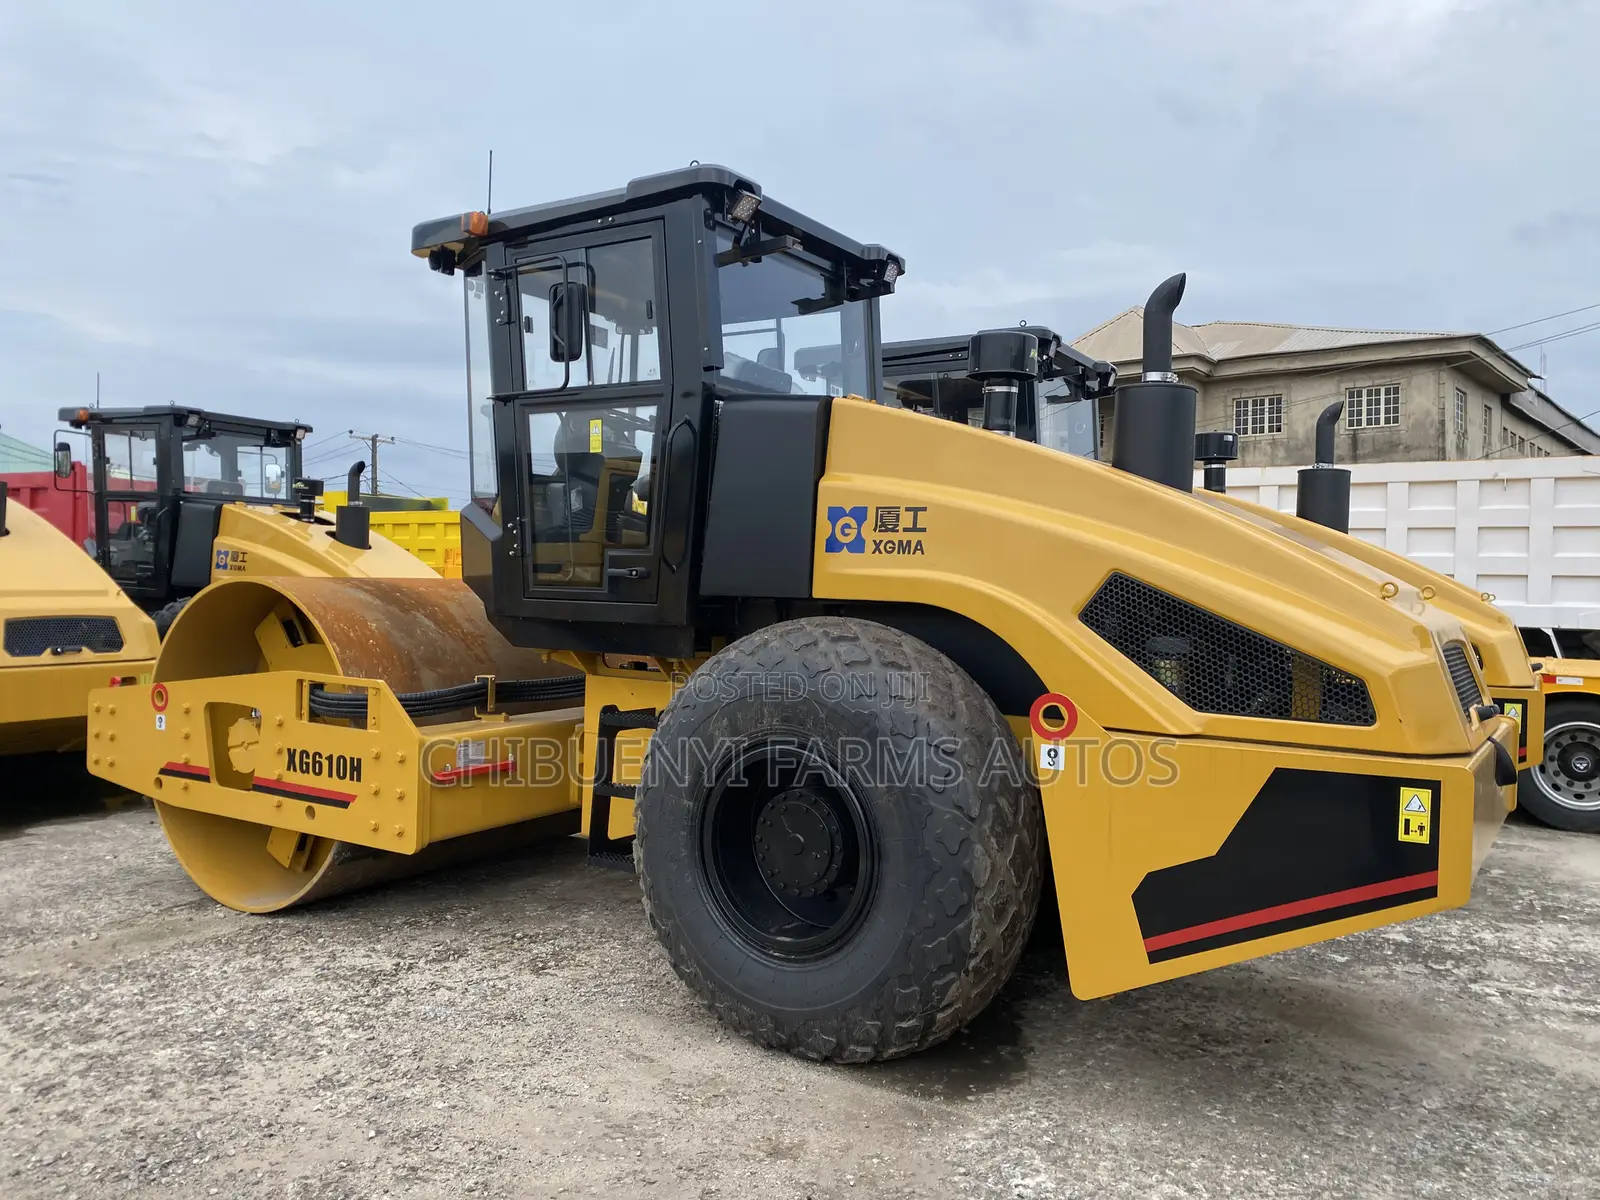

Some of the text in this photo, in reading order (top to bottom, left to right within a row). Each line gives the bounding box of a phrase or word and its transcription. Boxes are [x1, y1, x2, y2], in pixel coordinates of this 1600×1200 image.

[873, 506, 928, 533] 厦工
[871, 539, 925, 555] XGMA
[286, 747, 362, 783] XG610H
